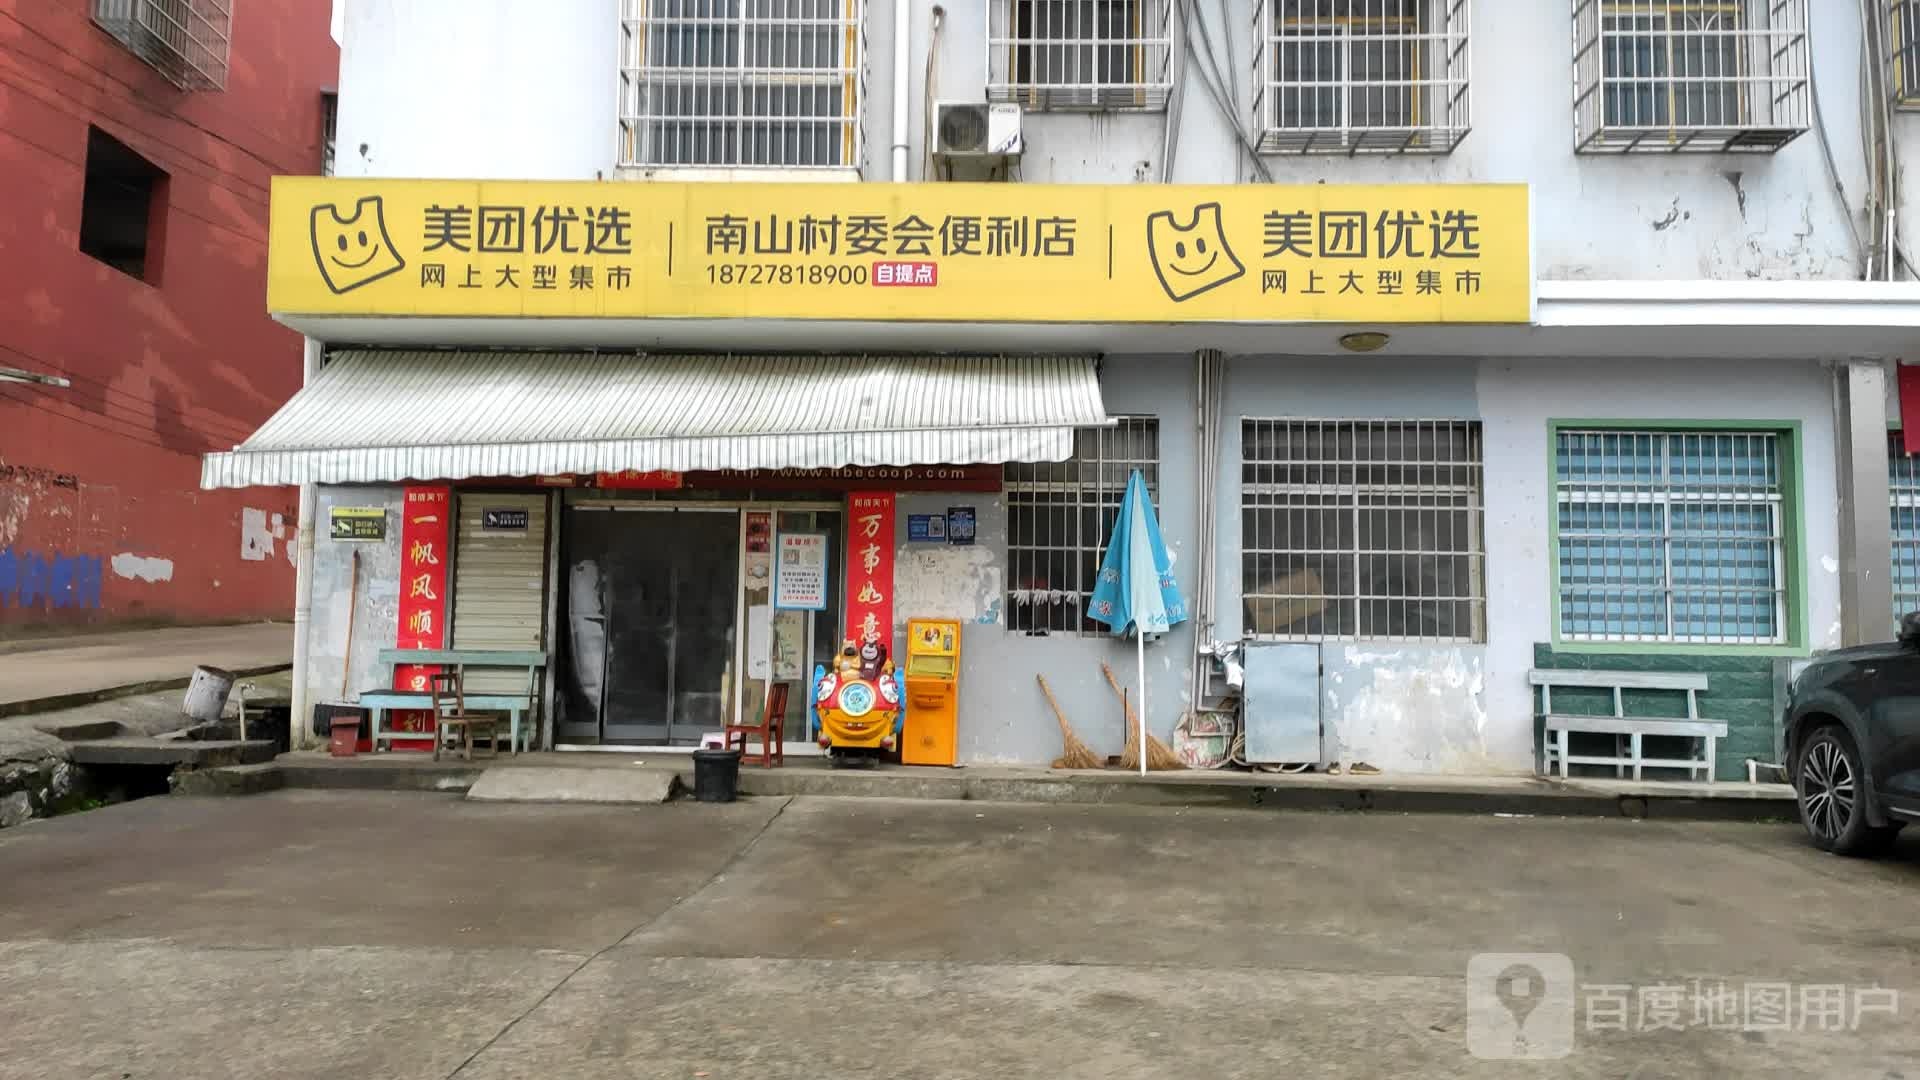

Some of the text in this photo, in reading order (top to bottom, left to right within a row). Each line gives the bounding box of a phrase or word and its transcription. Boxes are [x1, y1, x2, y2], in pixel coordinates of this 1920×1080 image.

[422, 204, 632, 255] 美团优选
[705, 213, 1077, 257] 南山村委会便利店
[1263, 209, 1481, 259] 美团优选
[421, 263, 632, 291] 网上大型集市
[706, 262, 935, 286] 18727818900 自提点
[1262, 269, 1481, 295] 网上大型集市
